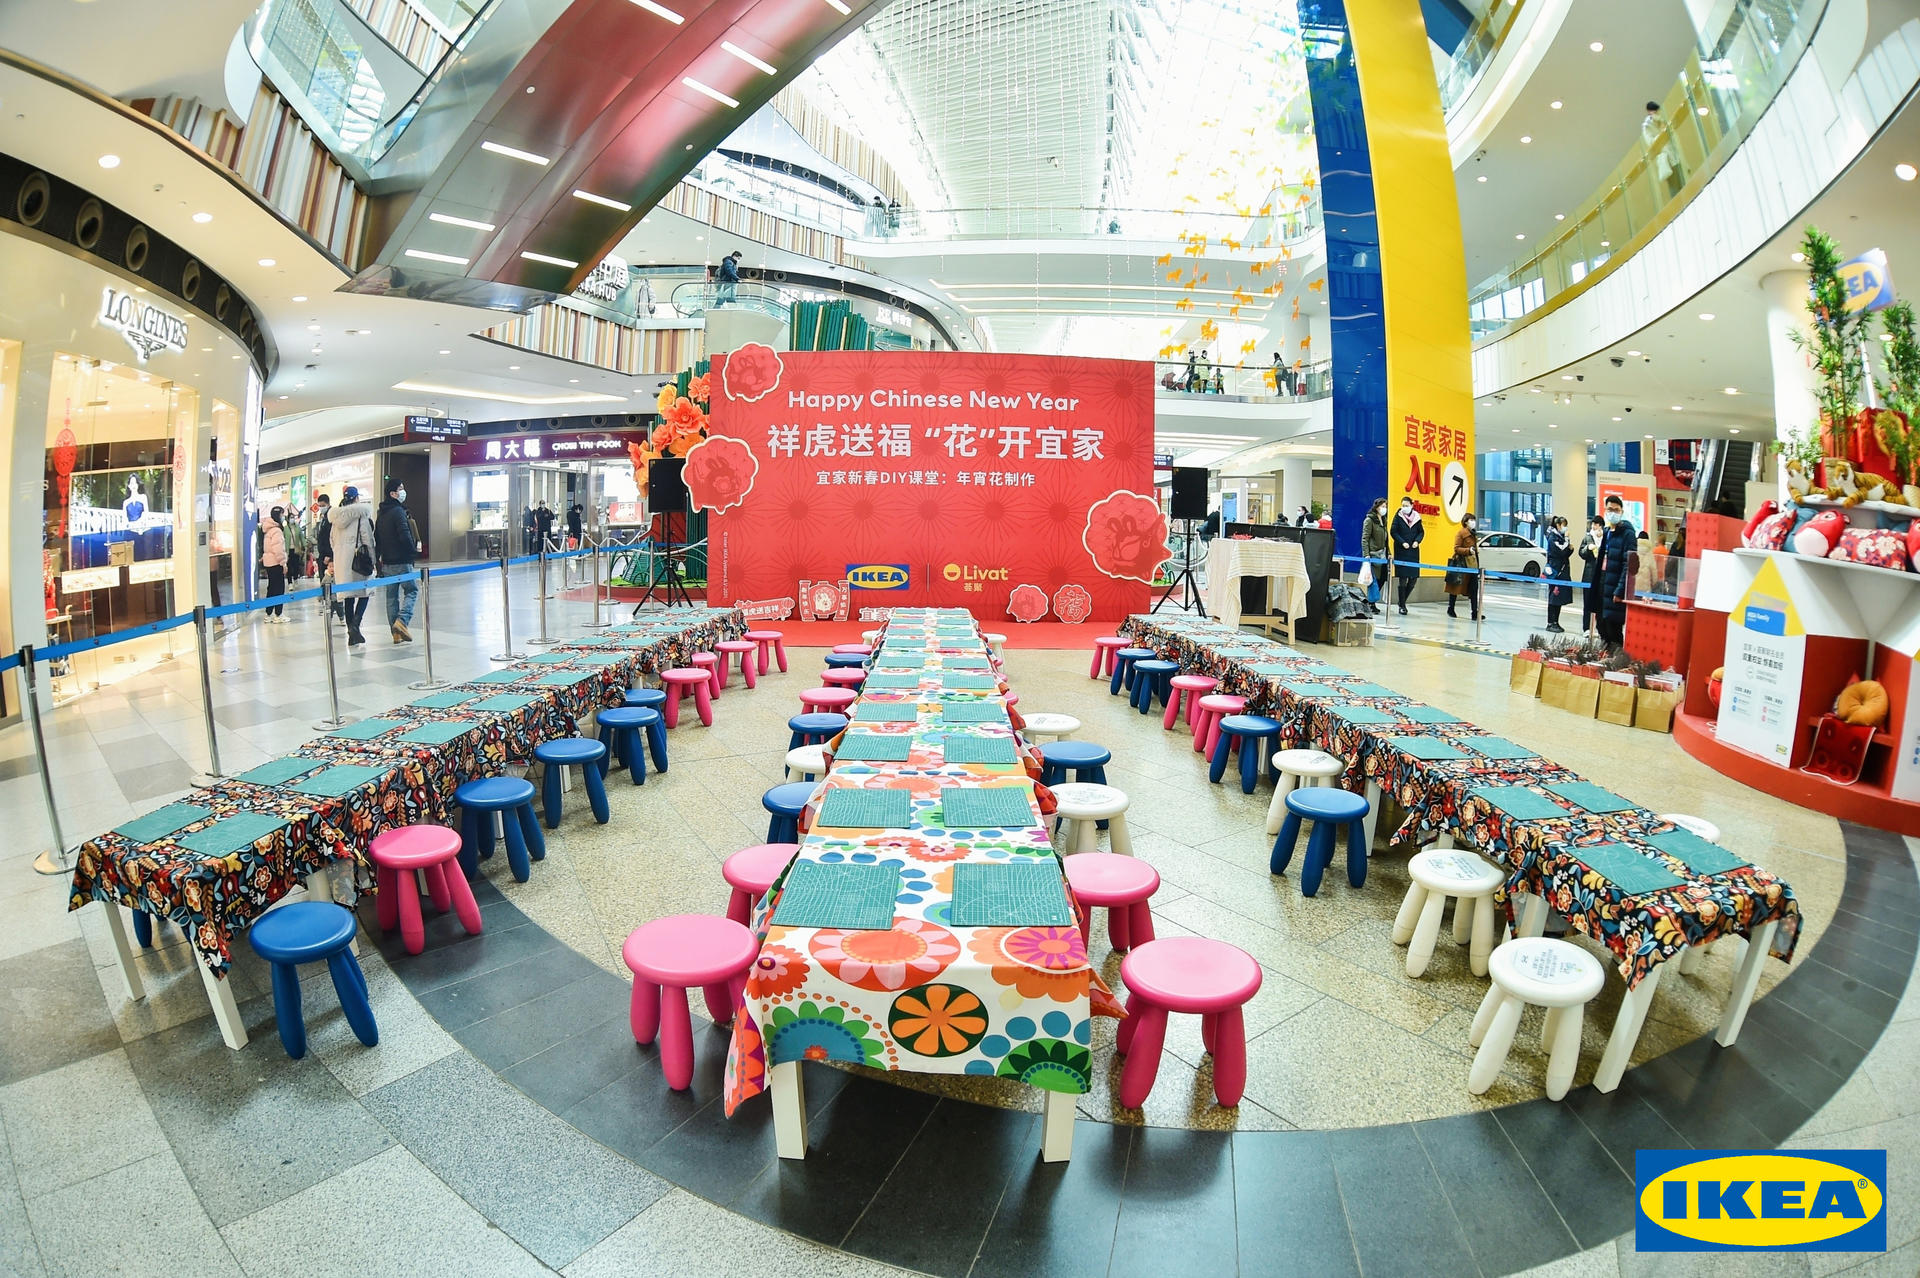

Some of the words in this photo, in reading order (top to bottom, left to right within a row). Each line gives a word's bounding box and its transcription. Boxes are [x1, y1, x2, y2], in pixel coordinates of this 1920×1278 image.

[599, 281, 617, 302] HUB
[105, 289, 189, 349] LONGINES
[788, 390, 864, 412] Happy
[870, 390, 962, 408] Chinese
[969, 390, 1021, 409] New
[1027, 392, 1079, 411] Year
[596, 440, 622, 449] FOOK
[1405, 415, 1467, 462] 宜家家居
[485, 439, 541, 460] 周大福
[1405, 455, 1440, 496] 入口
[852, 571, 904, 582] IKEA
[964, 565, 1009, 581] Livat
[861, 608, 896, 621] 宜家
